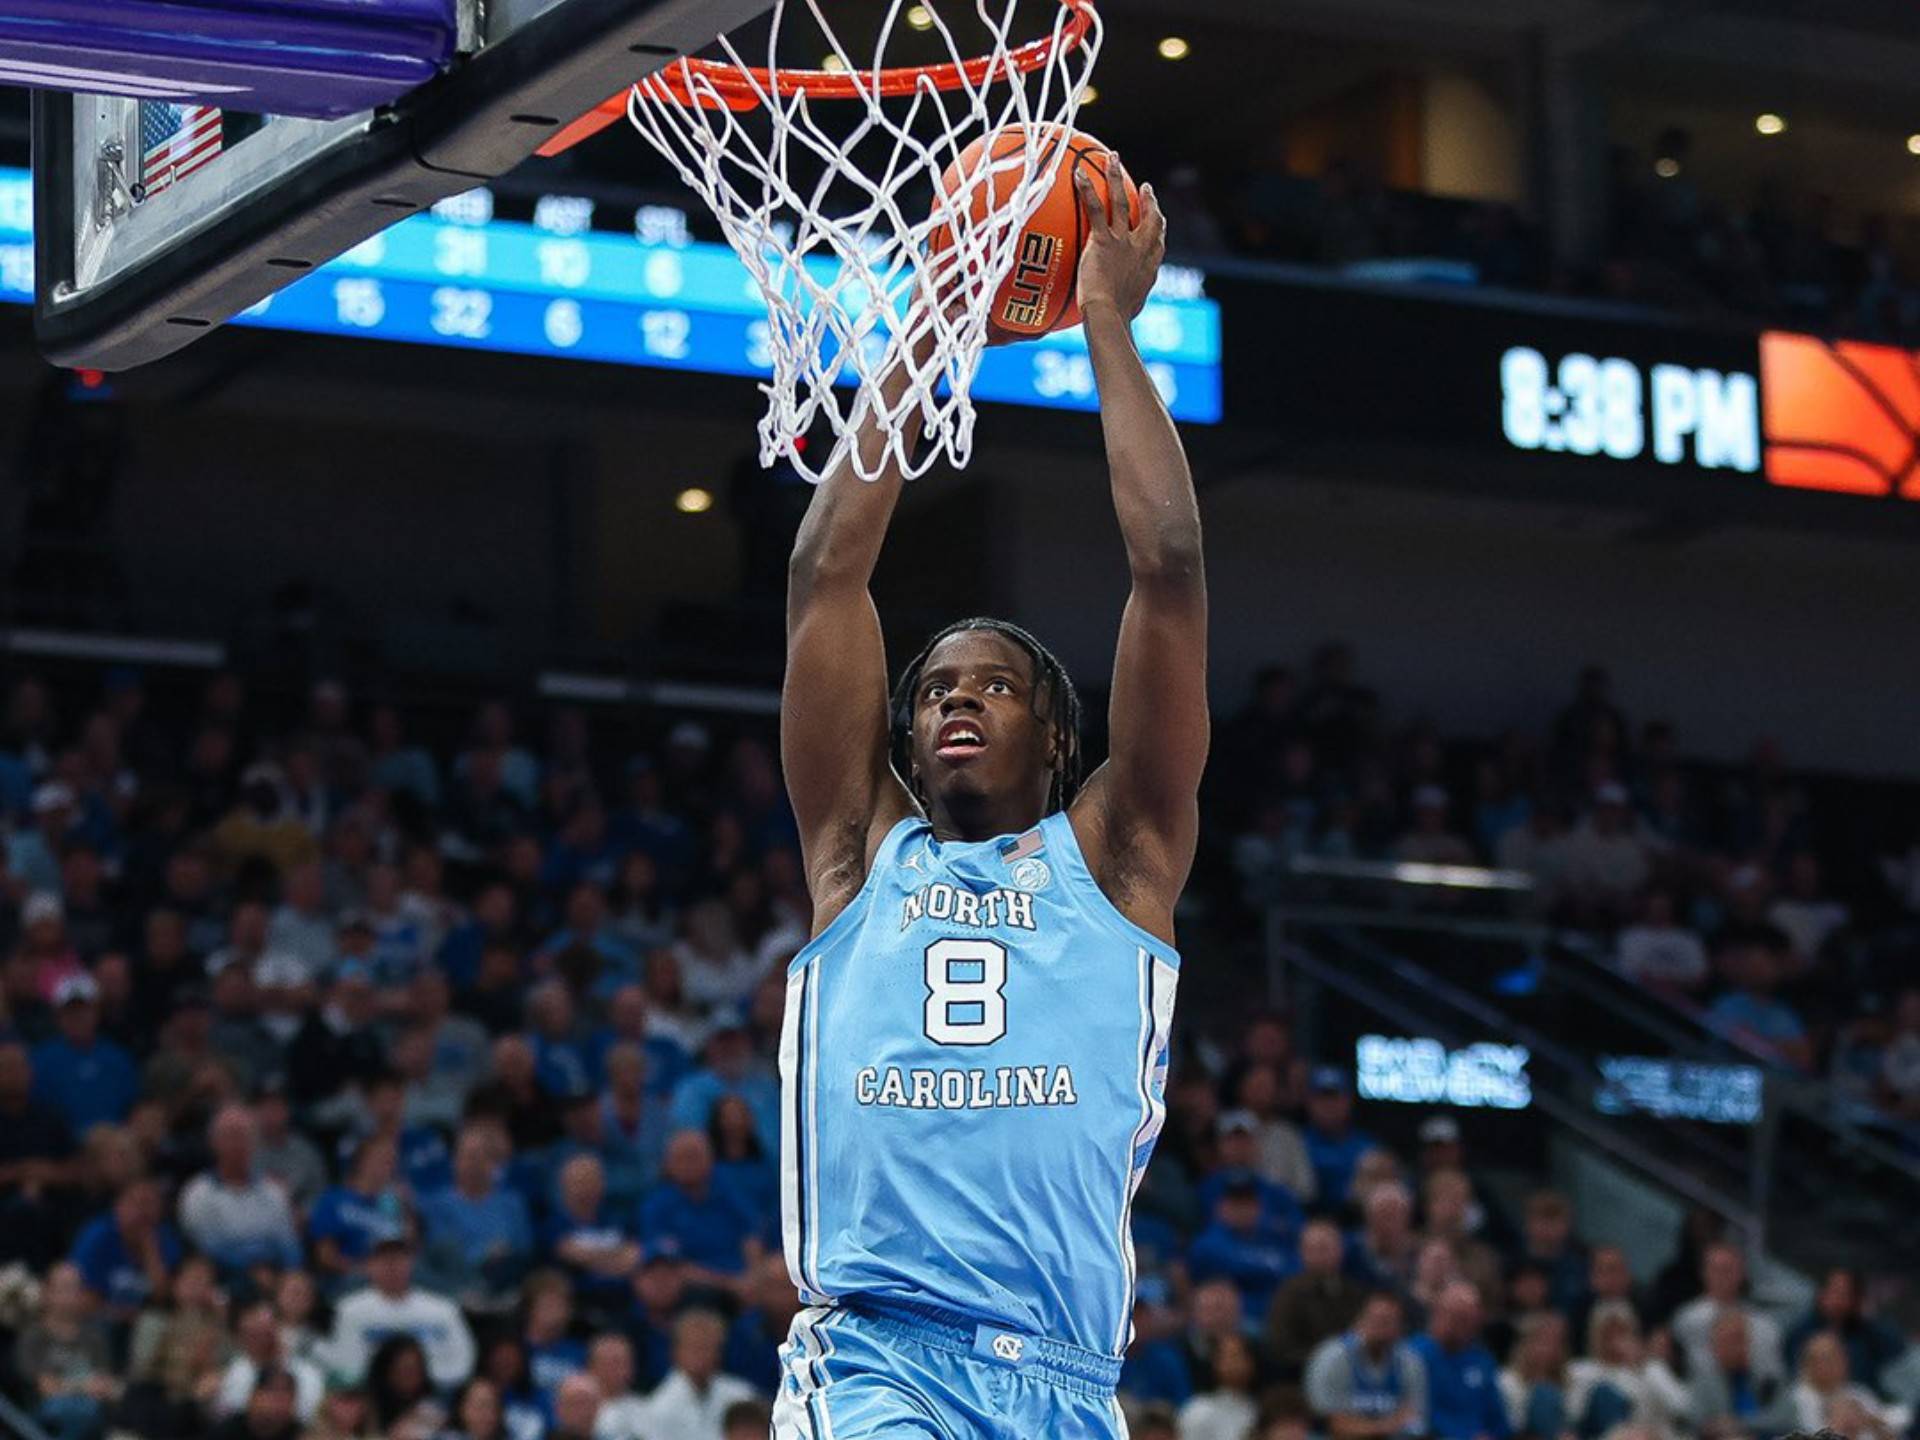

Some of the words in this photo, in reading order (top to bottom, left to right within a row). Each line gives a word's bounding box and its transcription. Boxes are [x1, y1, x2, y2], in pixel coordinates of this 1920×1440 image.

[431, 287, 492, 338] 32
[1002, 231, 1055, 326] ELITE
[1651, 364, 1760, 472] PM
[901, 883, 1036, 931] NORTH
[923, 938, 1007, 1046] 8
[856, 1065, 1077, 1110] CAROLINA
